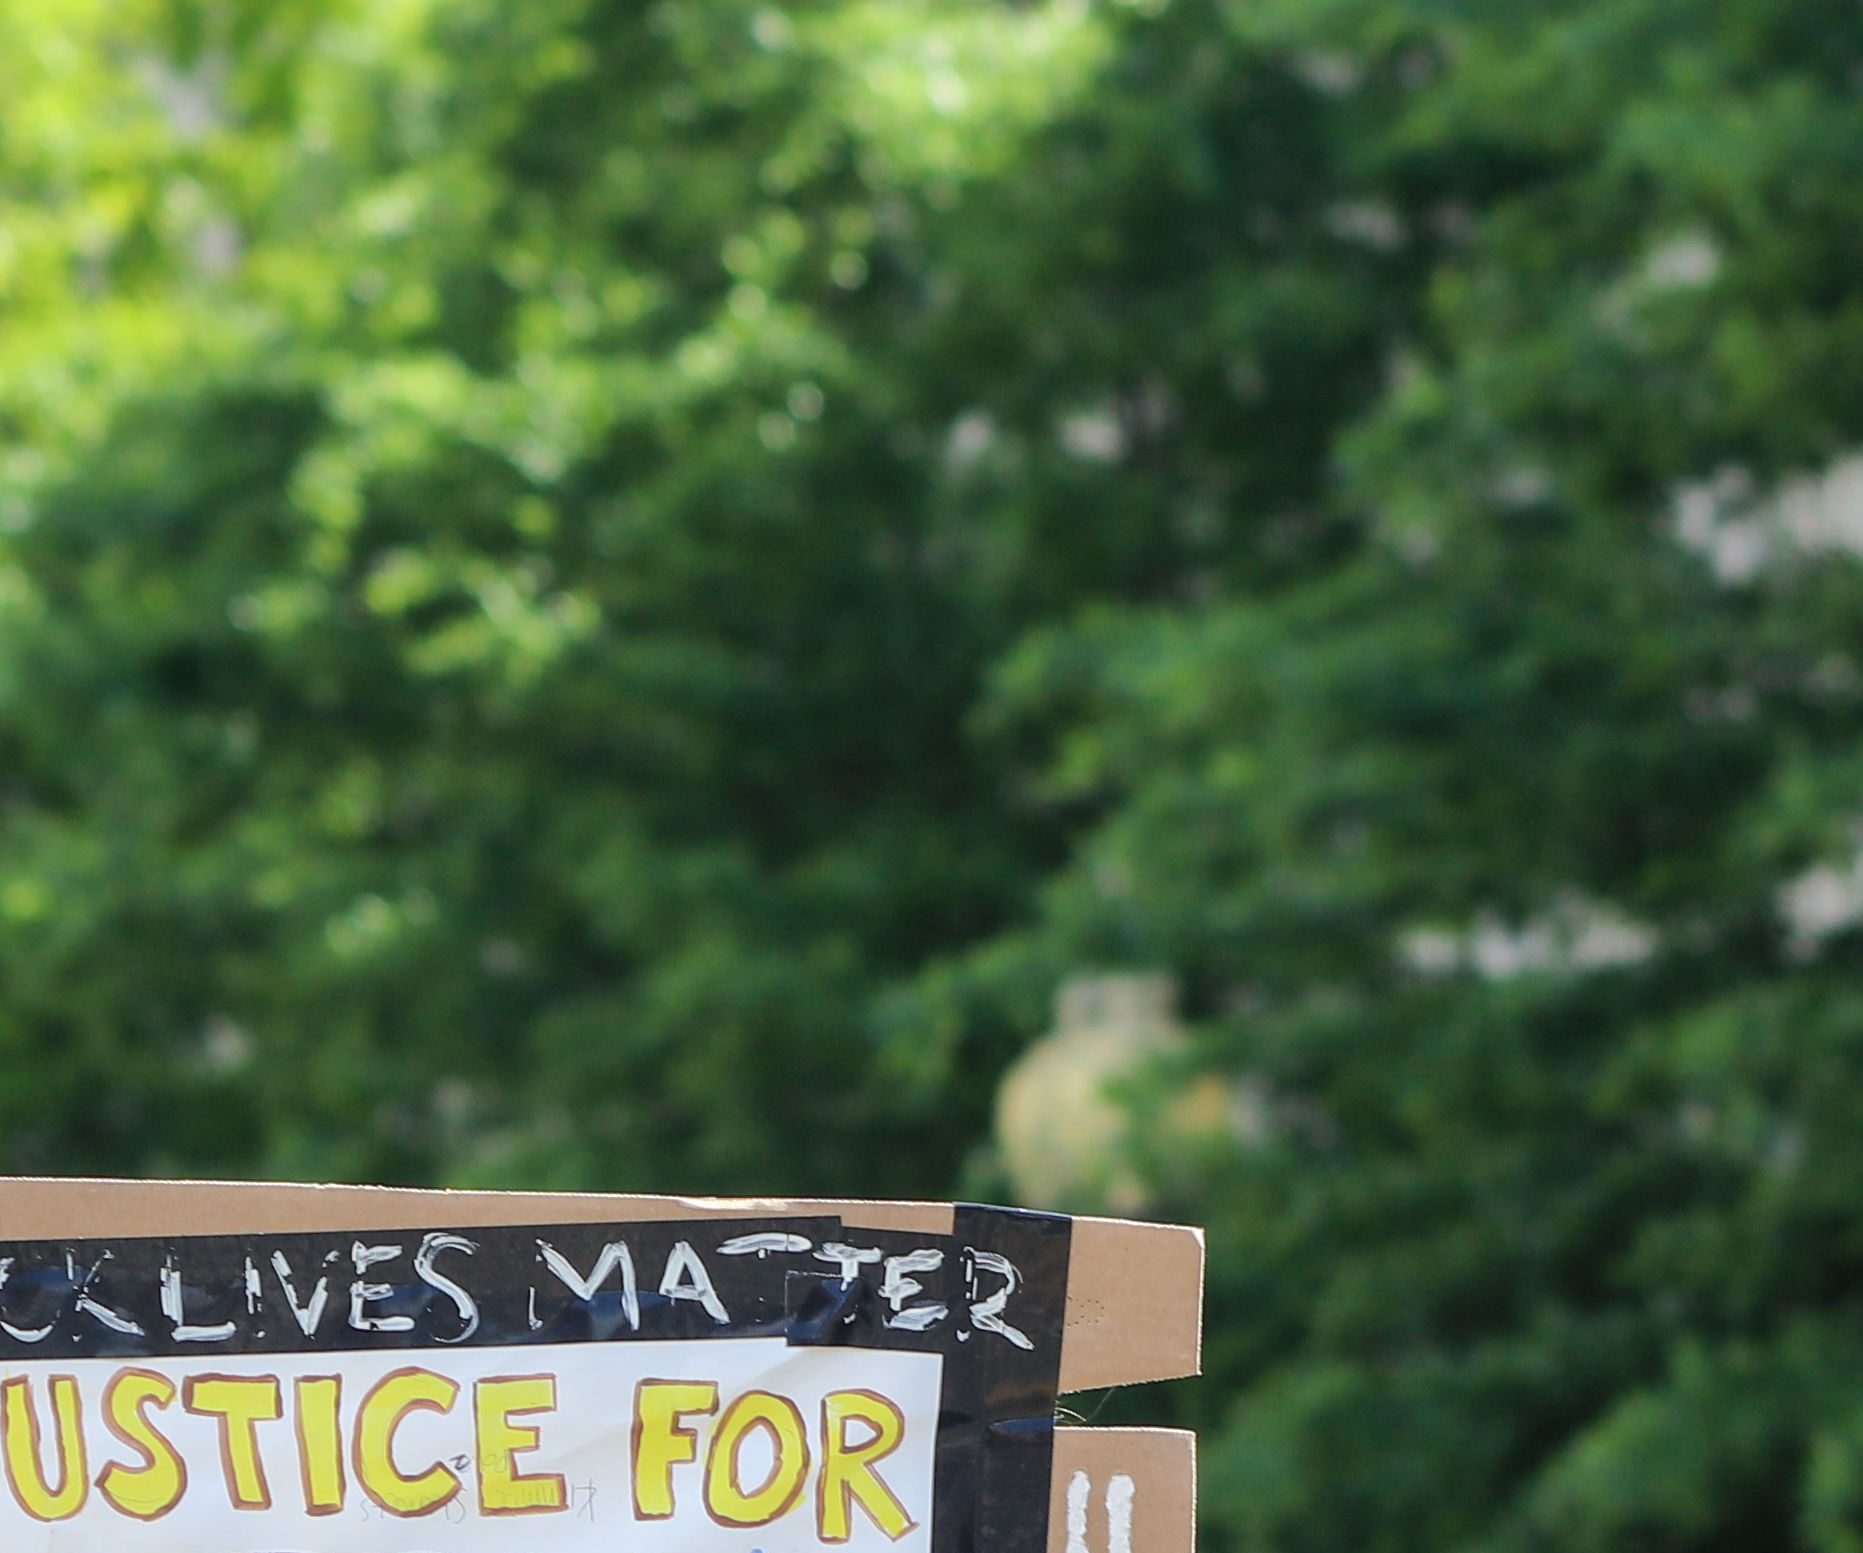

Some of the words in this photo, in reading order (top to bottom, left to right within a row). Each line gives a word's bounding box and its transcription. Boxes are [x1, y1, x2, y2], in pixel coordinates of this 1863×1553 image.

[158, 1232, 482, 1344] LIVES
[529, 1232, 1036, 1350] MATTER
[630, 1377, 920, 1545] FOR
